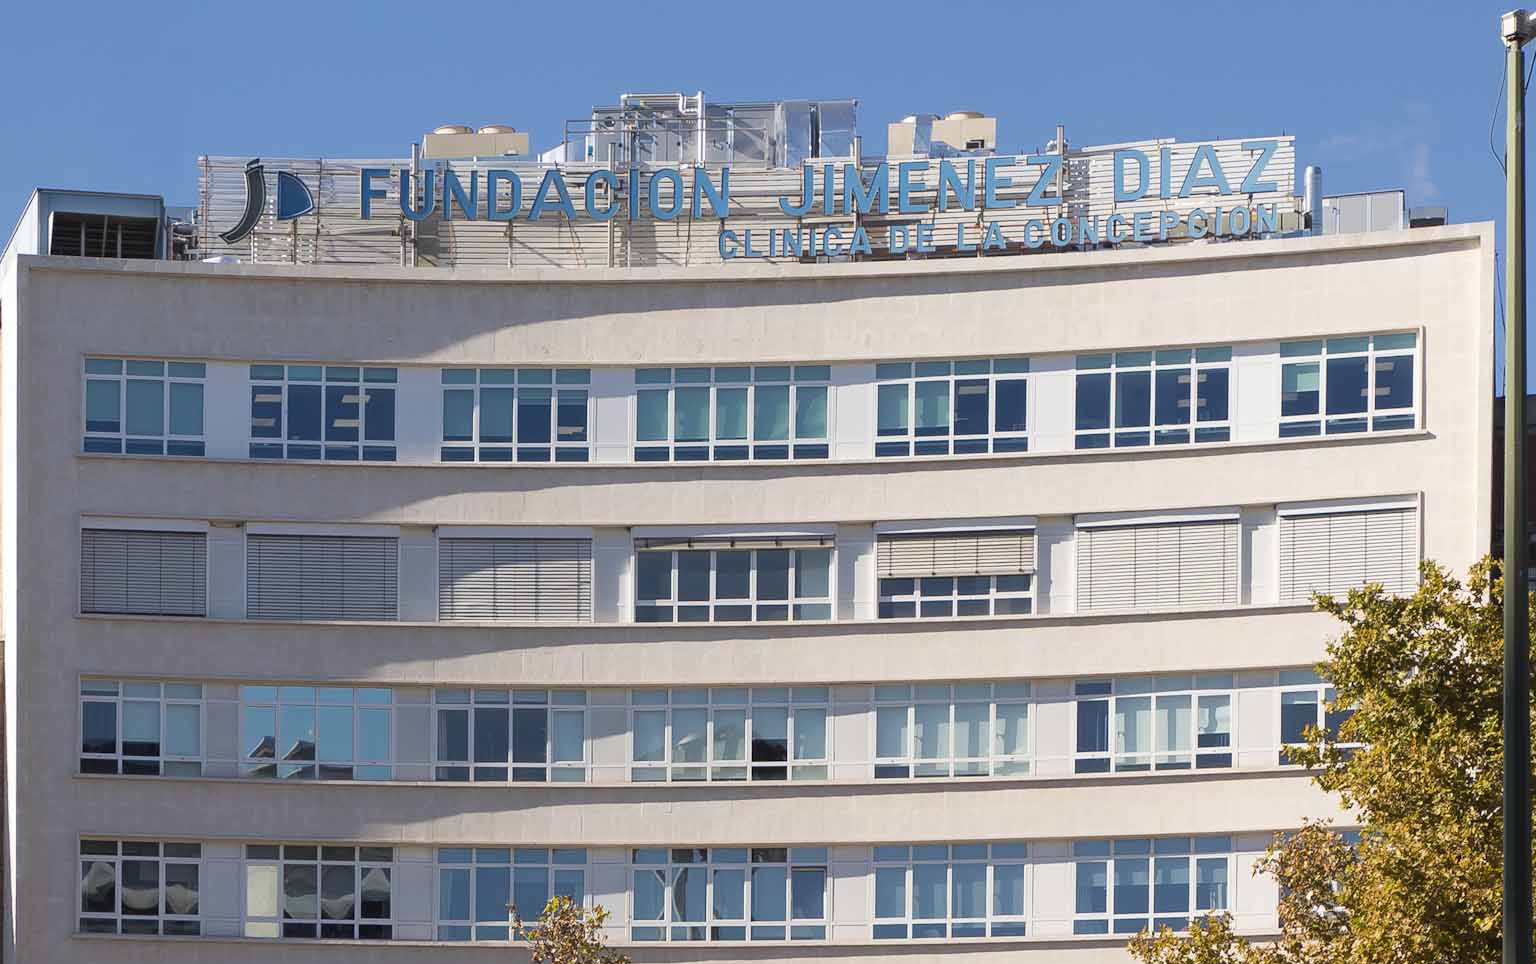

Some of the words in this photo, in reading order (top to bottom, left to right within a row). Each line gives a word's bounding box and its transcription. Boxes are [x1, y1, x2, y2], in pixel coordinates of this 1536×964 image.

[360, 166, 730, 222] FUNDACION
[779, 154, 1064, 217] JIMENEZ
[1113, 140, 1281, 203] DIAZ
[718, 226, 872, 259] CLINICA
[890, 224, 936, 254] DE
[957, 222, 1007, 252] LA
[1023, 203, 1279, 250] CONCEPCION
